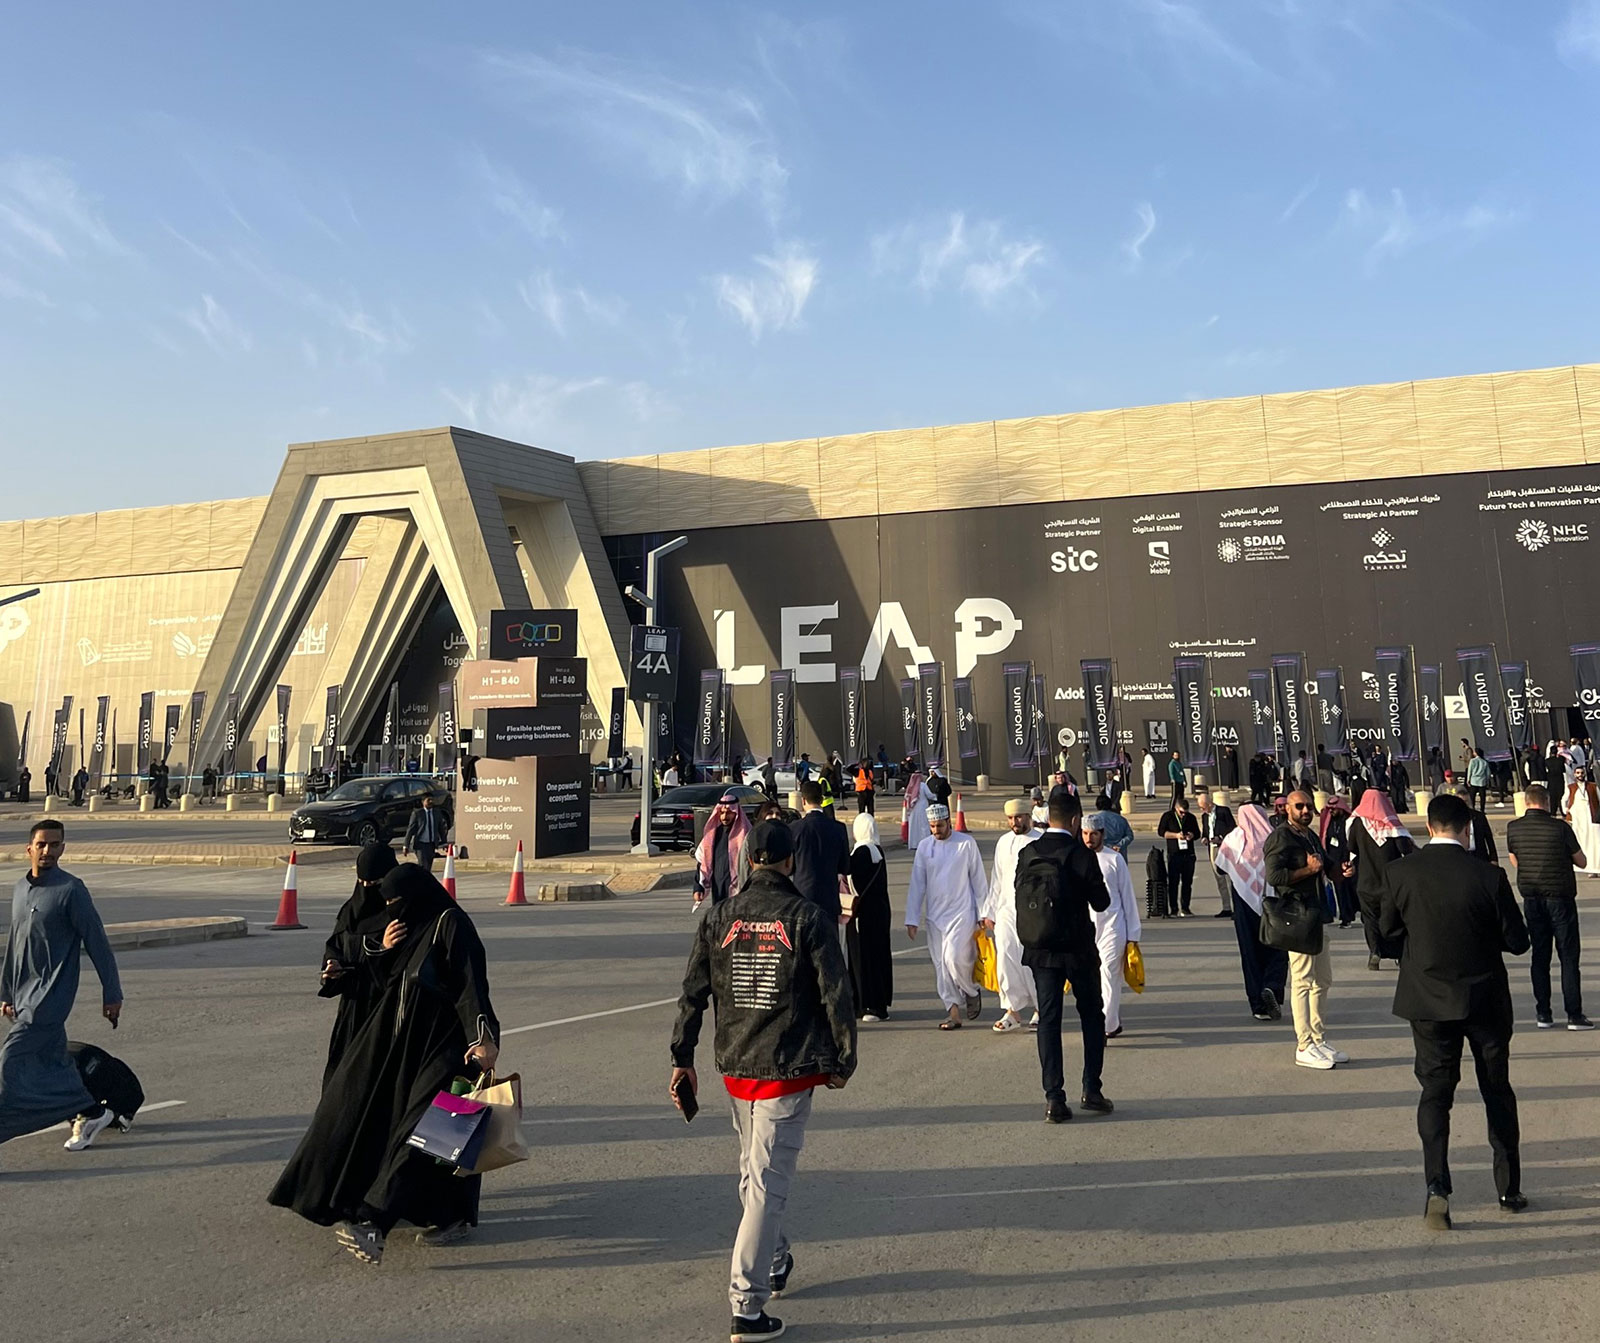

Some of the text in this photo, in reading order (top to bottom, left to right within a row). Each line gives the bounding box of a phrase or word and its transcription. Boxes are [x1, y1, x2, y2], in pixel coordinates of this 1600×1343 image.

[1537, 499, 1581, 507] Innovation
[1343, 511, 1378, 519] Strategic
[1133, 526, 1155, 534] Digital
[1219, 520, 1251, 528] Strategic
[1552, 524, 1587, 535] NHC
[1243, 535, 1286, 548] SDAIA
[1051, 546, 1098, 572] stc
[1364, 550, 1406, 564] تحكم
[714, 597, 1022, 684] LEAP
[637, 653, 671, 674] 4A
[1286, 680, 1300, 742] UNIFONIC
[1388, 673, 1401, 736] UNIFONIC
[1452, 700, 1465, 714] 2
[1473, 673, 1494, 738] UNIFONIC
[704, 692, 712, 744] UNIFONIC
[1014, 687, 1023, 745] UNIFONIC
[1095, 685, 1108, 744] UNIFONIC
[1189, 682, 1201, 743] UNIFONIC
[400, 718, 414, 727] Visit
[422, 718, 430, 726] at
[444, 711, 455, 744] ntdp
[1346, 728, 1385, 739] IFONI
[471, 776, 519, 787] Driven by AI.
[546, 781, 581, 791] One powerful
[549, 794, 578, 803] ecosystem.
[474, 822, 513, 833] Designed for
[476, 832, 510, 840] enterprises.
